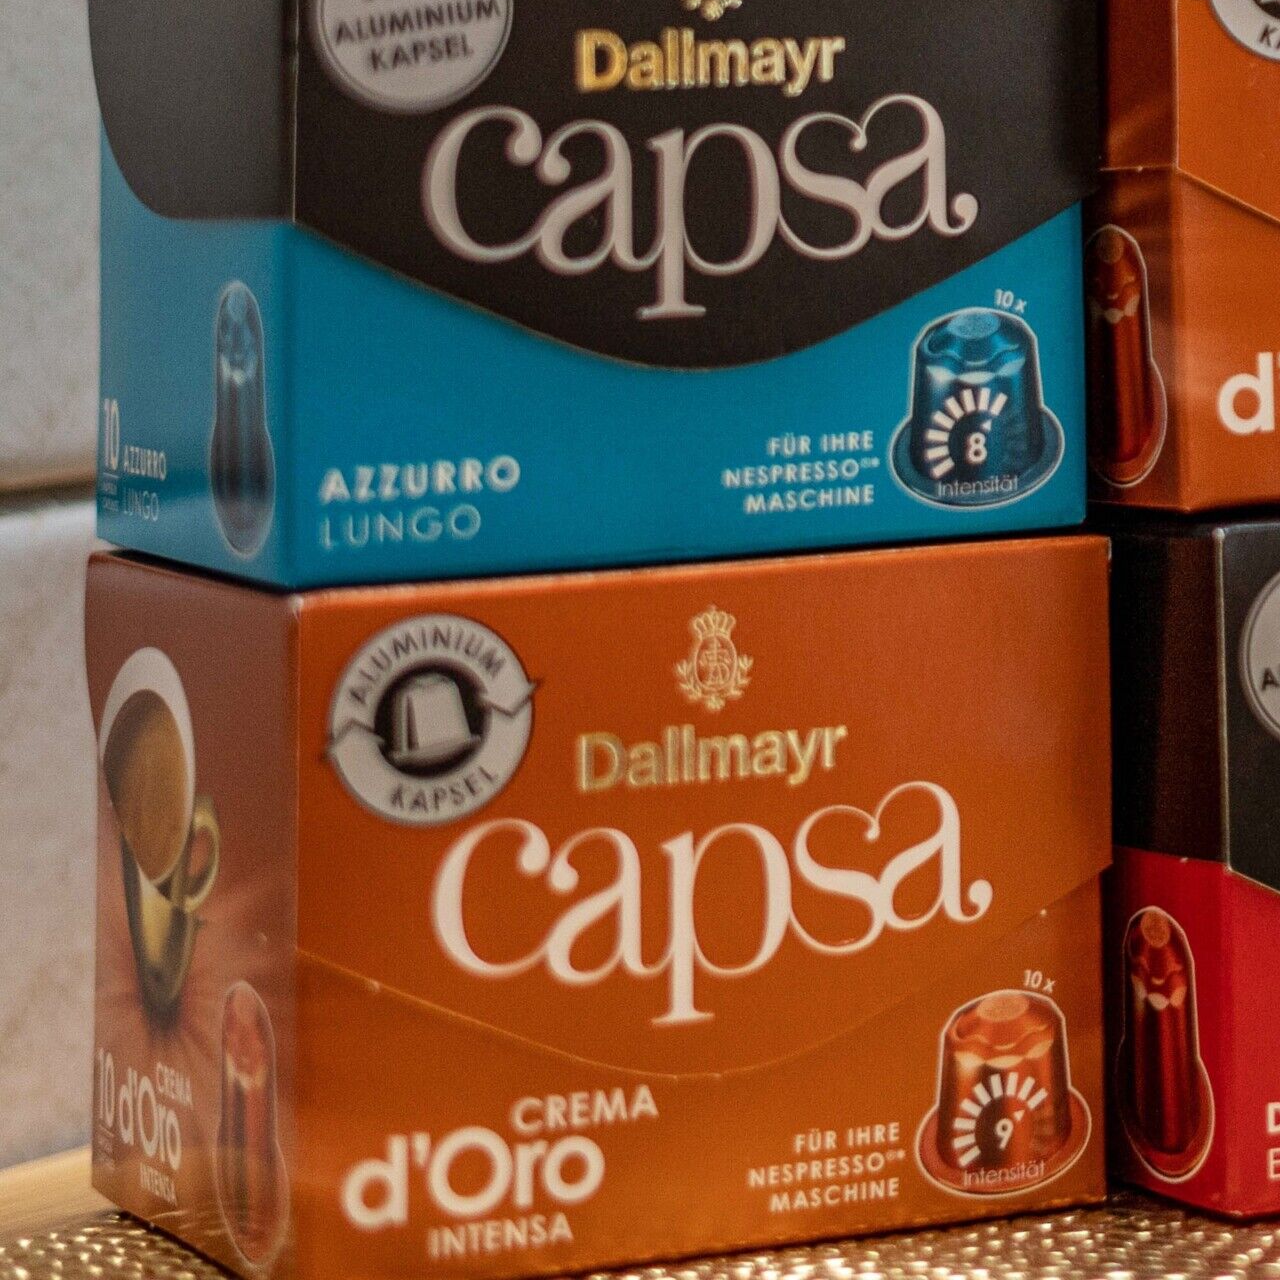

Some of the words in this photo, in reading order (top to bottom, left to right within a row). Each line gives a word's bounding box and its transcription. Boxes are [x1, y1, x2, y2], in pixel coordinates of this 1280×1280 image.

[368, 33, 474, 74] KAPSEL
[576, 27, 846, 98] Dallmayr
[124, 445, 167, 481] AZZURRO
[767, 436, 811, 458] FÜR
[820, 430, 874, 454] IHRE
[967, 432, 987, 464] 8
[318, 454, 521, 505] AZZURRO
[744, 484, 874, 515] MASCHINE
[937, 475, 1018, 497] Intensität
[319, 504, 482, 551] LUNGO
[349, 625, 506, 705] ALUMINIUM
[576, 723, 849, 793] Dallmayr
[389, 766, 497, 814] KAPSEL
[118, 1067, 183, 1171] d'Oro
[510, 1083, 660, 1135] CREMA
[793, 1128, 837, 1155] FÜR
[847, 1122, 901, 1147] IHRE
[994, 1118, 1014, 1149] 9
[340, 1125, 606, 1233] d'Oro
[769, 1176, 901, 1213] MASCHINE
[962, 1160, 1046, 1187] Intensität
[427, 1211, 574, 1260] INTENSA
